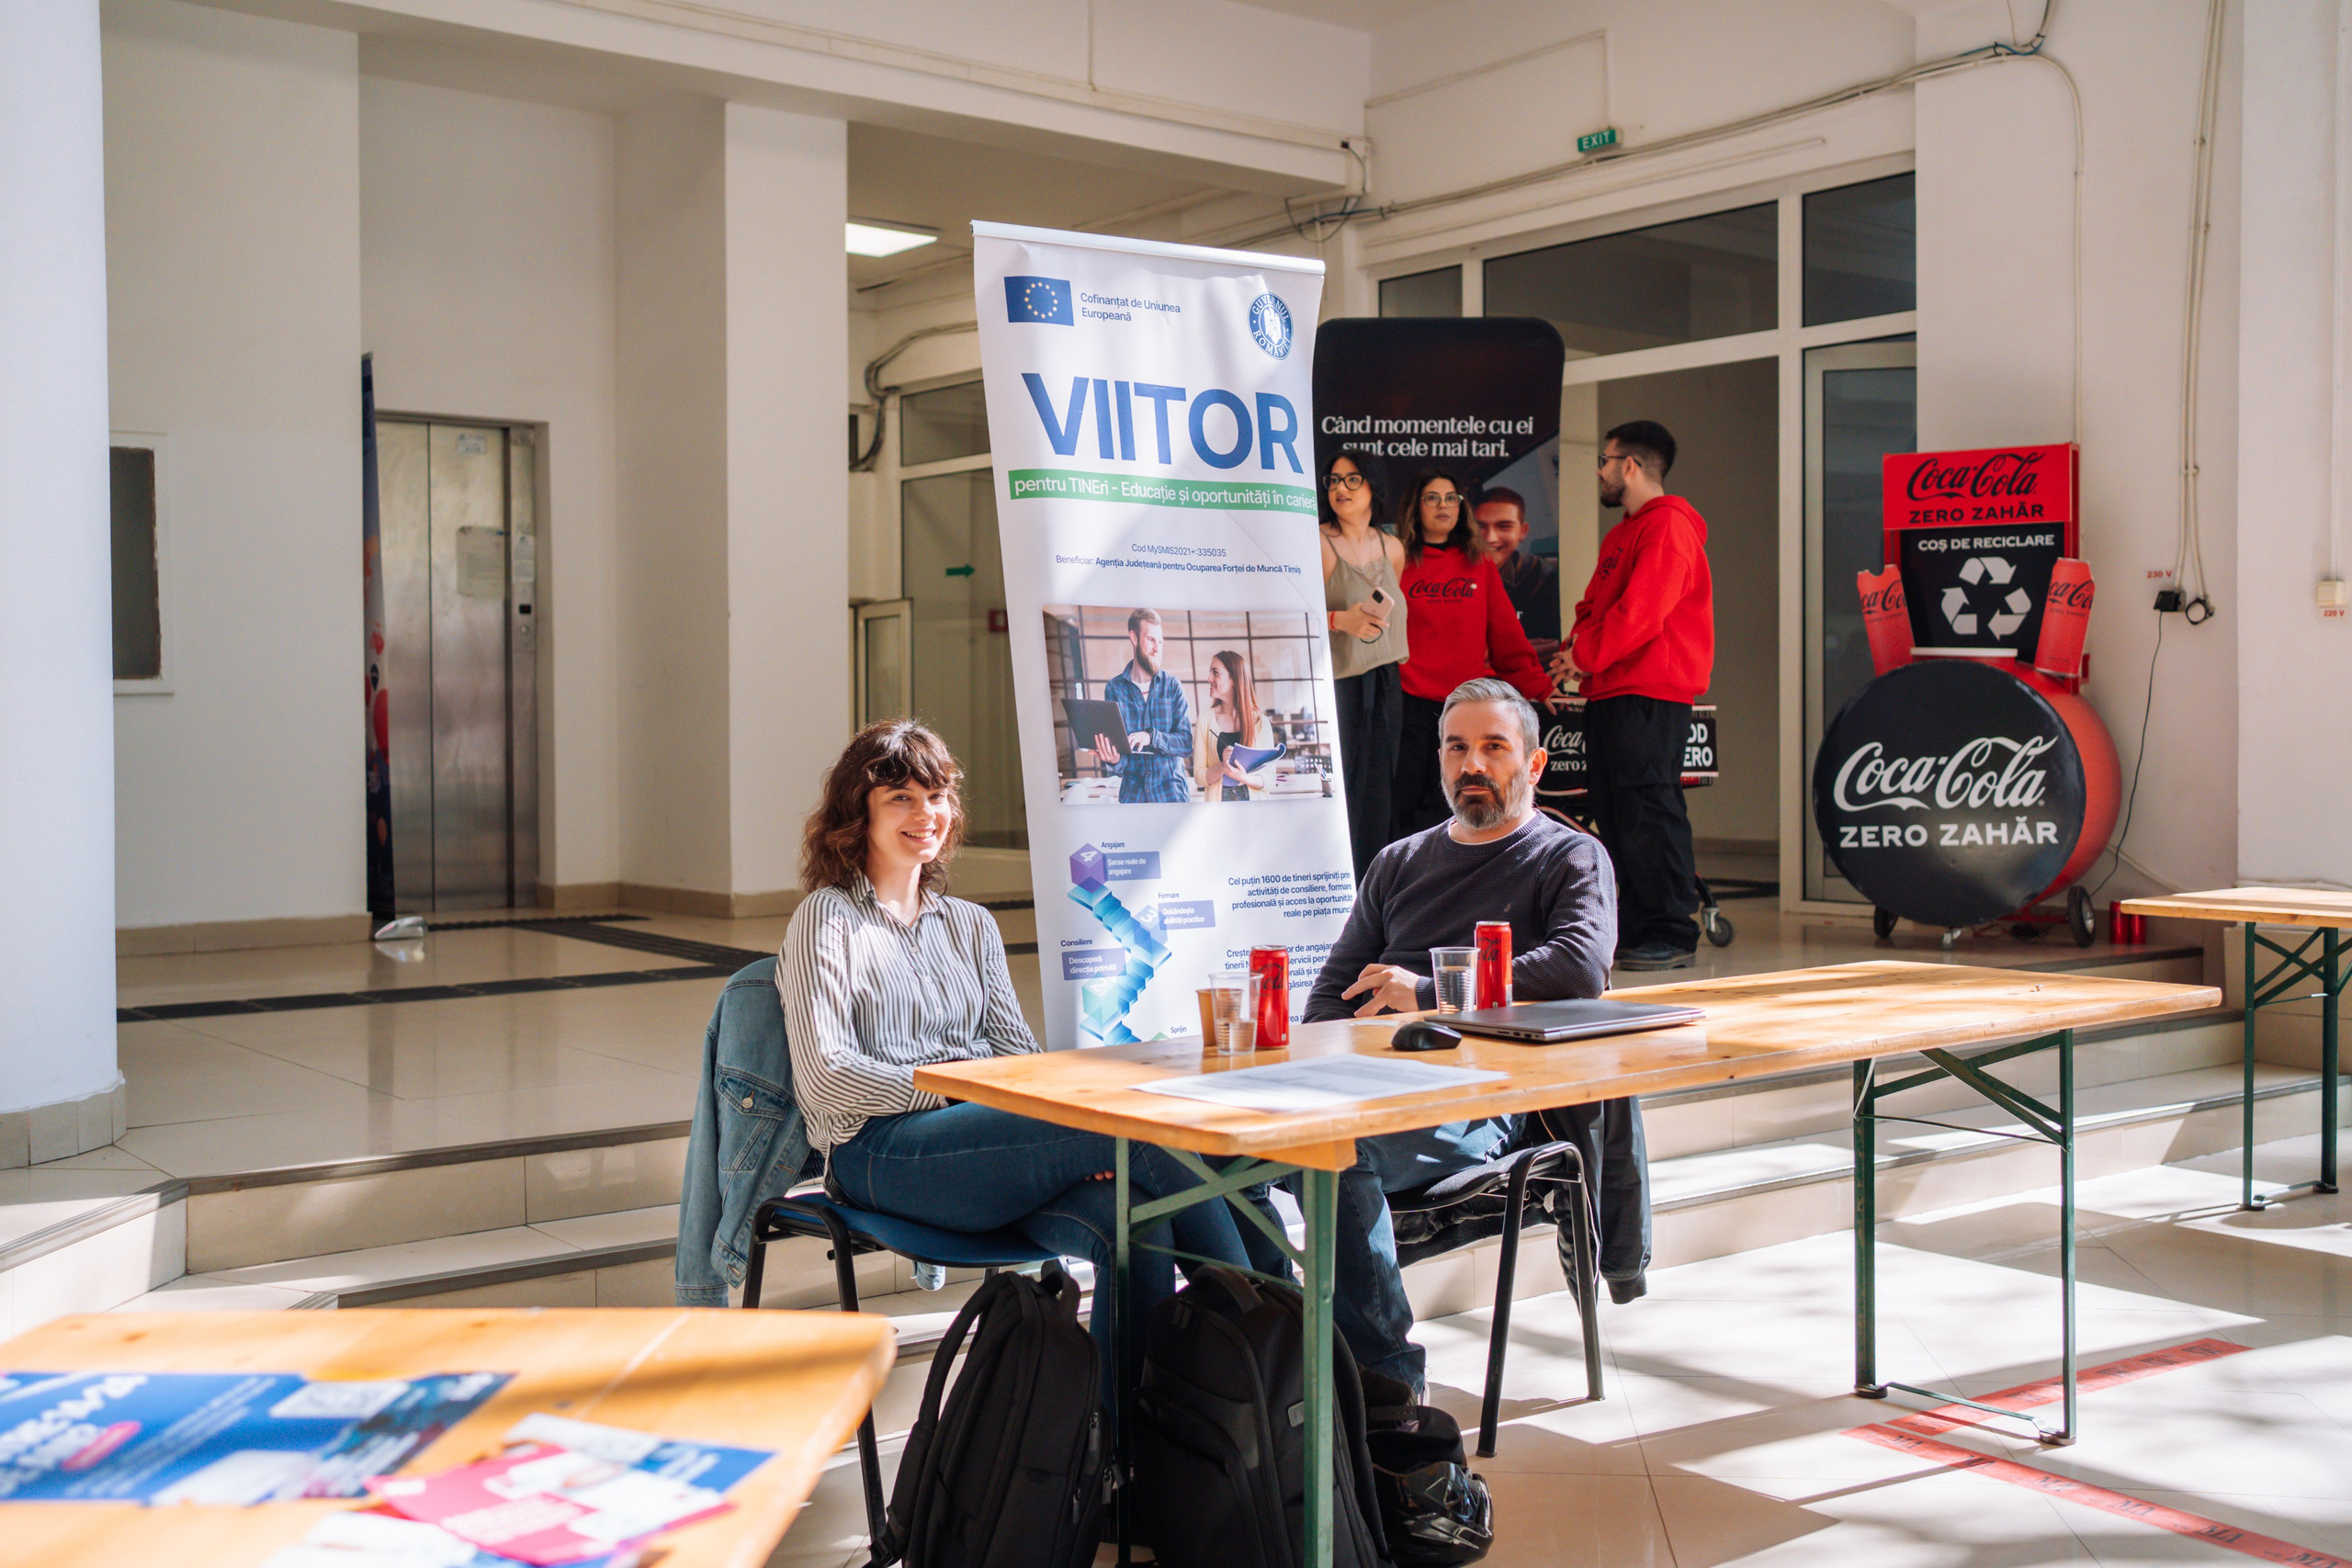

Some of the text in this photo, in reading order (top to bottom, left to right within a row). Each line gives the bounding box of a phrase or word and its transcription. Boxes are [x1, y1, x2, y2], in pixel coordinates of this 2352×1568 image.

[1582, 130, 1611, 149] EXIT
[1080, 293, 1181, 313] Cofinanțat de Uniunea
[1251, 294, 1289, 322] GUVERNUL
[1081, 308, 1132, 321] Europeană
[1021, 372, 1304, 474] VIITOR
[1321, 415, 1533, 434] Când momentele cu ei
[1387, 438, 1428, 457] cele
[1431, 438, 1467, 457] mai
[1471, 438, 1510, 457] tari.
[1906, 452, 2046, 502] Coca-Cola
[1014, 477, 1067, 497] pentru
[1069, 477, 1109, 495] TINEri
[1121, 481, 1176, 503] Educație
[1179, 487, 1190, 505] și
[1192, 489, 1271, 508] oportunități
[1272, 490, 1284, 505] în
[1286, 493, 1317, 511] carieră
[1909, 502, 2044, 524] ZERO ZAHĂR
[1131, 544, 1147, 552] Cod
[1918, 534, 2054, 553] COȘ DE RECICLARE
[1056, 555, 1094, 565] Beneficiar:
[1095, 558, 1125, 569] Agenția
[1125, 559, 1162, 570] Județeană
[1162, 562, 1186, 570] pentru
[1186, 562, 1222, 573] Ocuparea
[1223, 564, 1245, 574] Forței
[1257, 564, 1283, 573] Muncă
[1283, 565, 1302, 575] Timiș
[2147, 570, 2172, 579] 230 V
[1408, 577, 1476, 599] Coca-Cola
[1683, 746, 1713, 767] ERO
[1550, 761, 1580, 772] zero
[1833, 735, 2059, 812] Coca-Cola
[1839, 816, 2059, 848] ZERO ZAHĂR
[1101, 841, 1125, 850] Angajare
[1080, 850, 1098, 863] 4
[1228, 871, 1351, 886] Cel puțin 1600 de tineri sprijiniți prin
[1247, 883, 1352, 897] activități de consiliere, formare
[1232, 898, 1277, 911] profesională
[1278, 899, 1284, 908] și
[1285, 897, 1307, 906] acces
[1307, 897, 1315, 905] la
[1283, 909, 1302, 918] reale
[1303, 909, 1312, 919] pe
[1313, 908, 1331, 918] piața
[1060, 938, 1093, 947] Consiliere
[1295, 944, 1305, 953] de
[1306, 942, 1332, 953] angajar
[1069, 955, 1102, 964] Descoperă
[1225, 961, 1245, 970] tinerii
[1306, 966, 1313, 977] și
[1170, 1025, 1187, 1034] Sprijin
